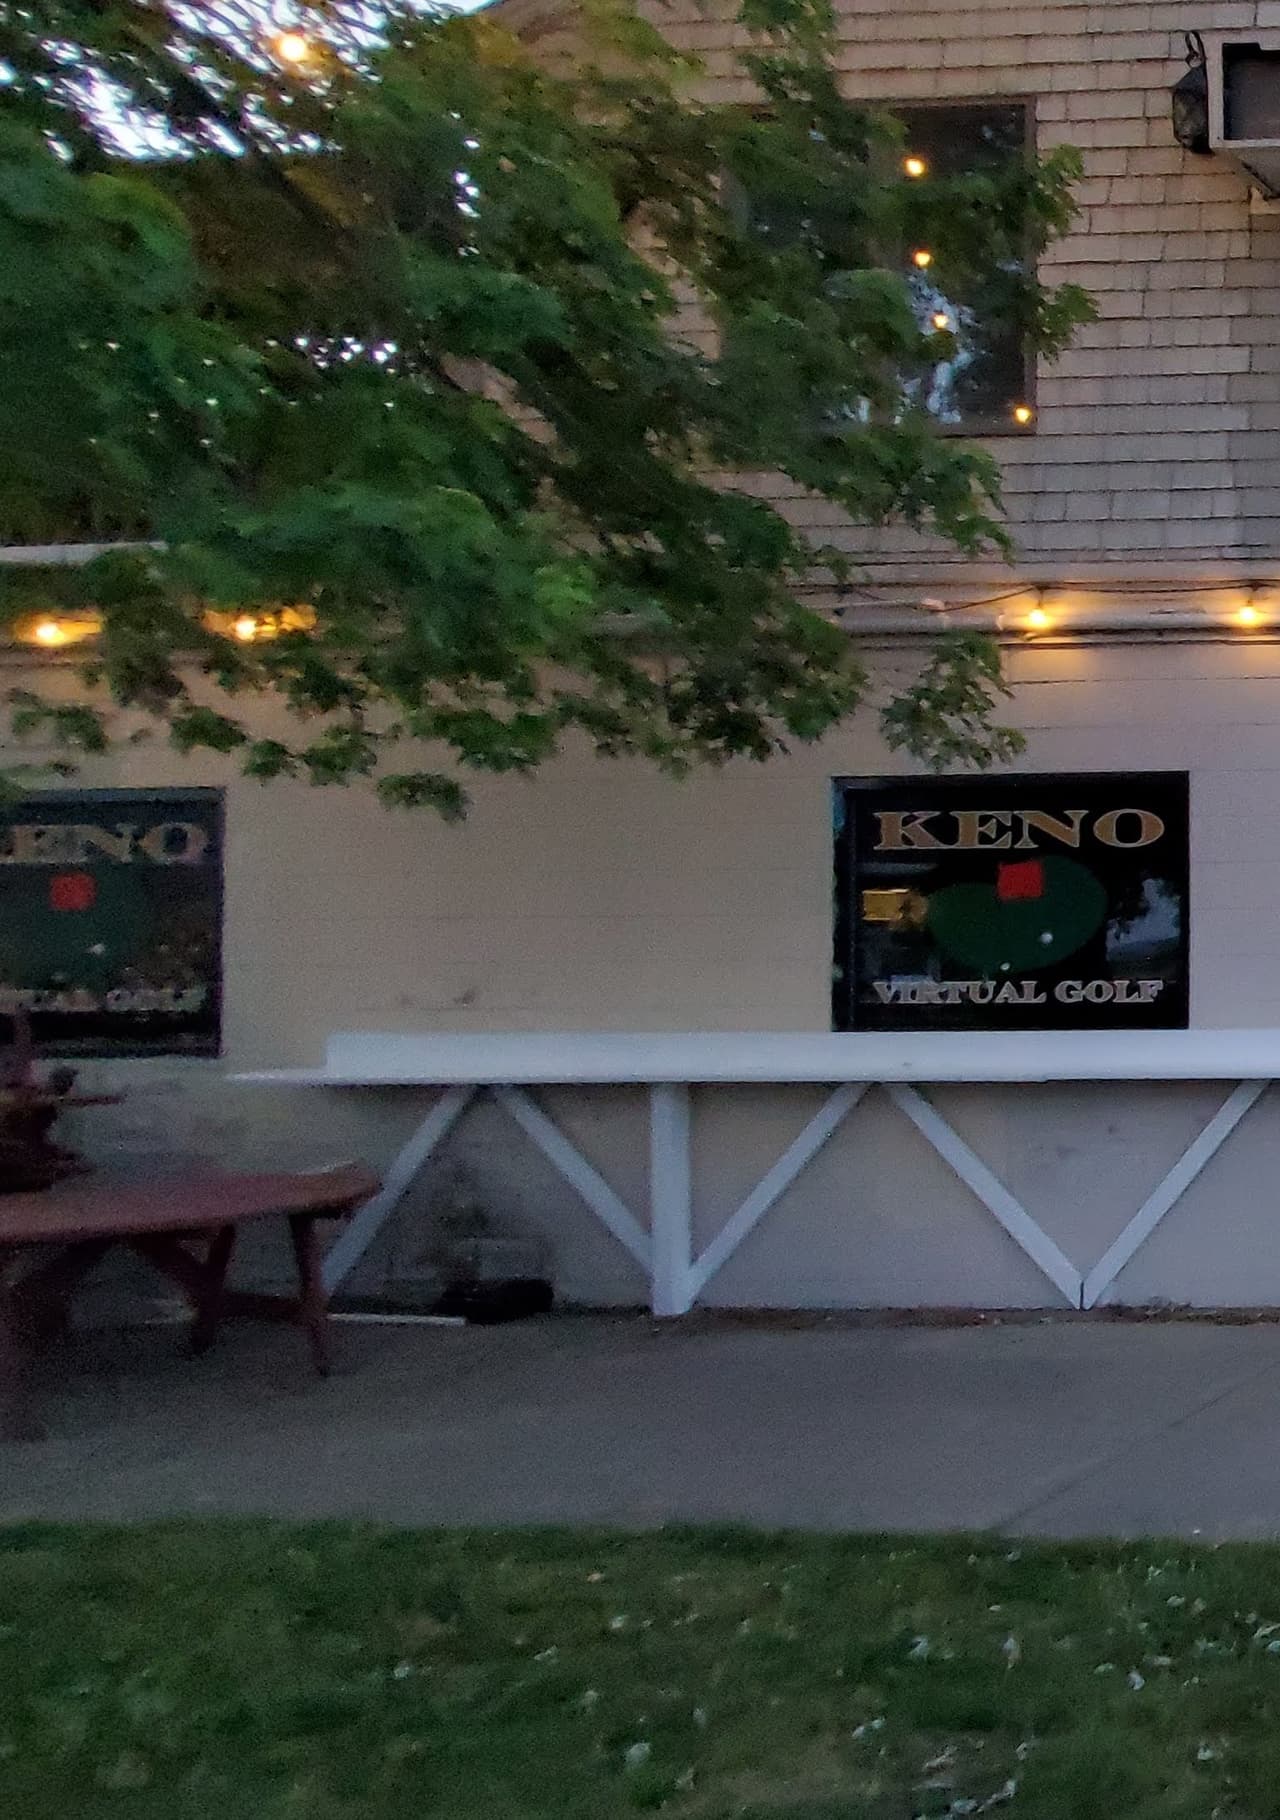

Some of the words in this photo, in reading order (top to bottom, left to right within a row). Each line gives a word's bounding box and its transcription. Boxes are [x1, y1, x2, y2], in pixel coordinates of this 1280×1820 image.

[0, 823, 208, 864] ENO
[873, 809, 1165, 850] KENO
[873, 980, 1047, 1004] VIRTUAL
[1055, 980, 1164, 1003] GOLF
